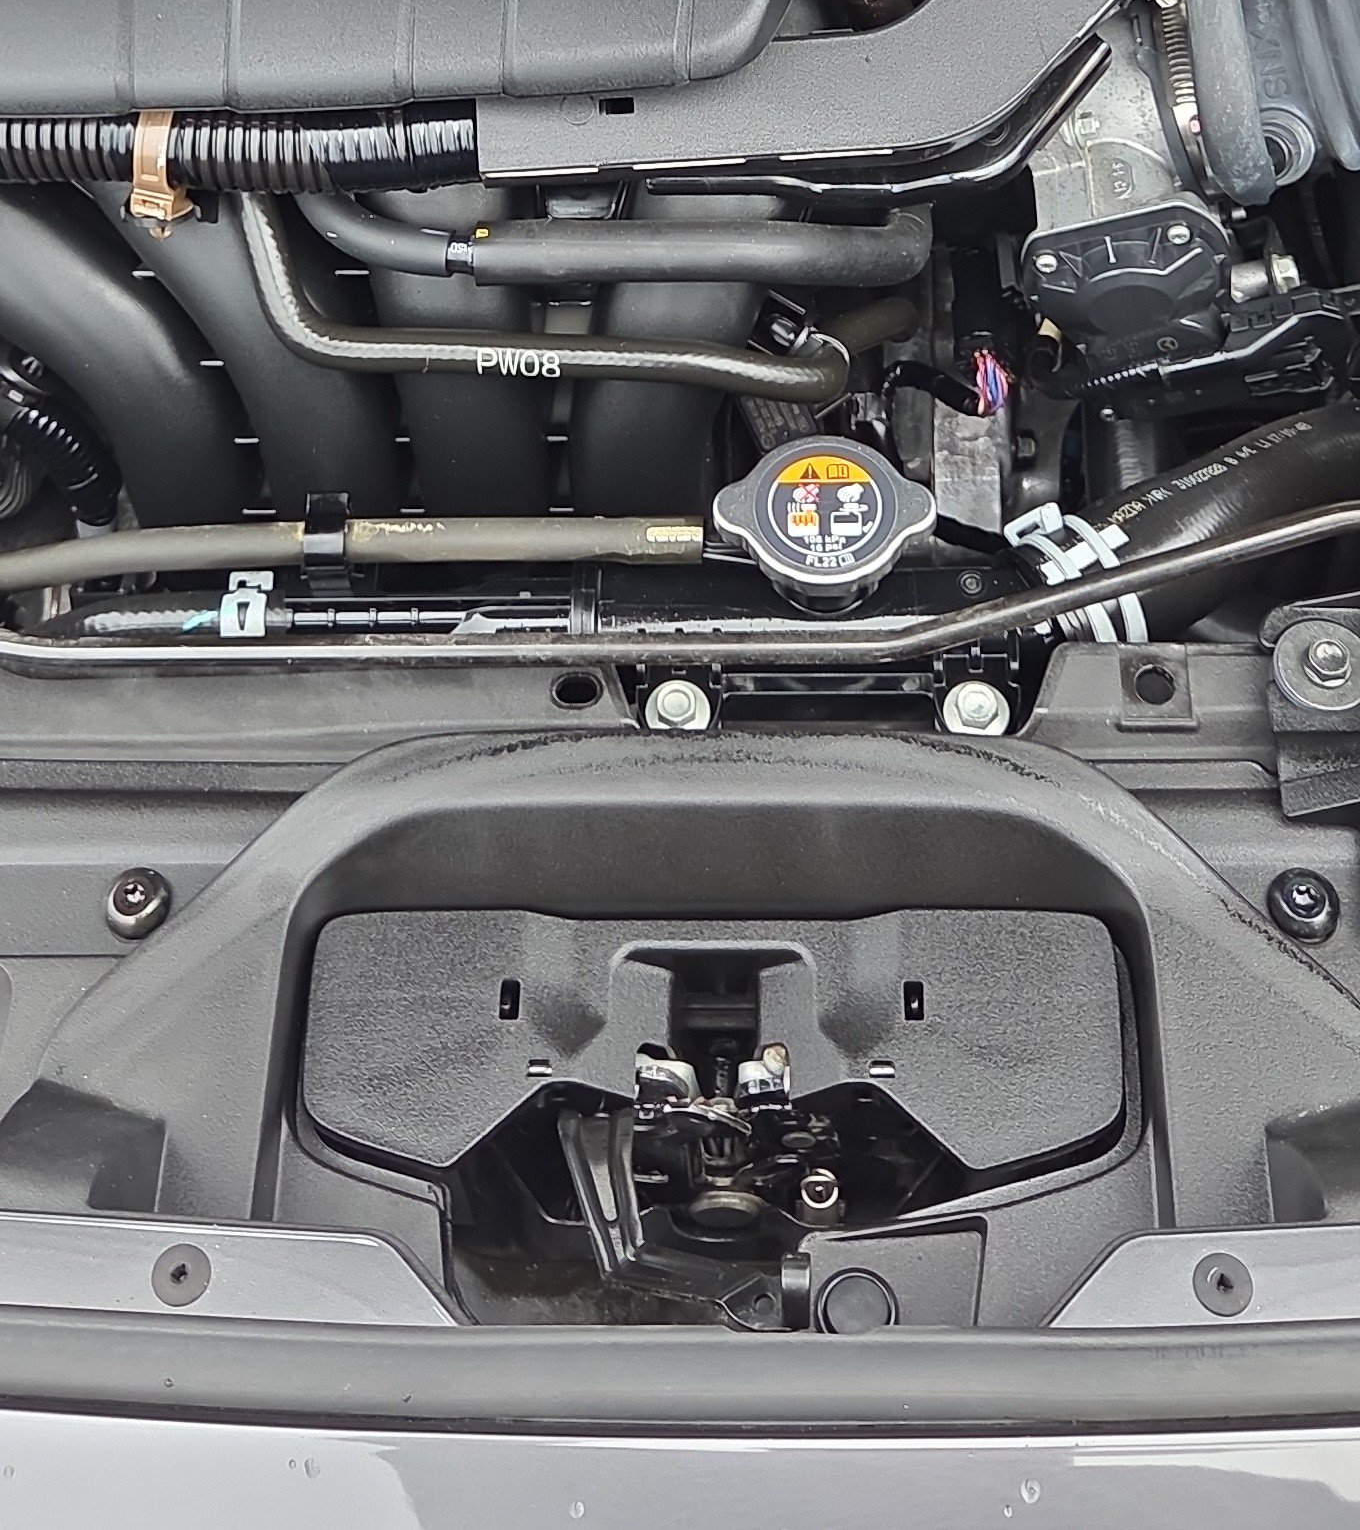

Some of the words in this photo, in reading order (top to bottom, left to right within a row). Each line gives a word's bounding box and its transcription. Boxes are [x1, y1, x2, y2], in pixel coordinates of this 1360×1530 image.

[475, 348, 562, 379] PW08
[825, 534, 846, 545] kPa
[805, 554, 838, 568] FL22
